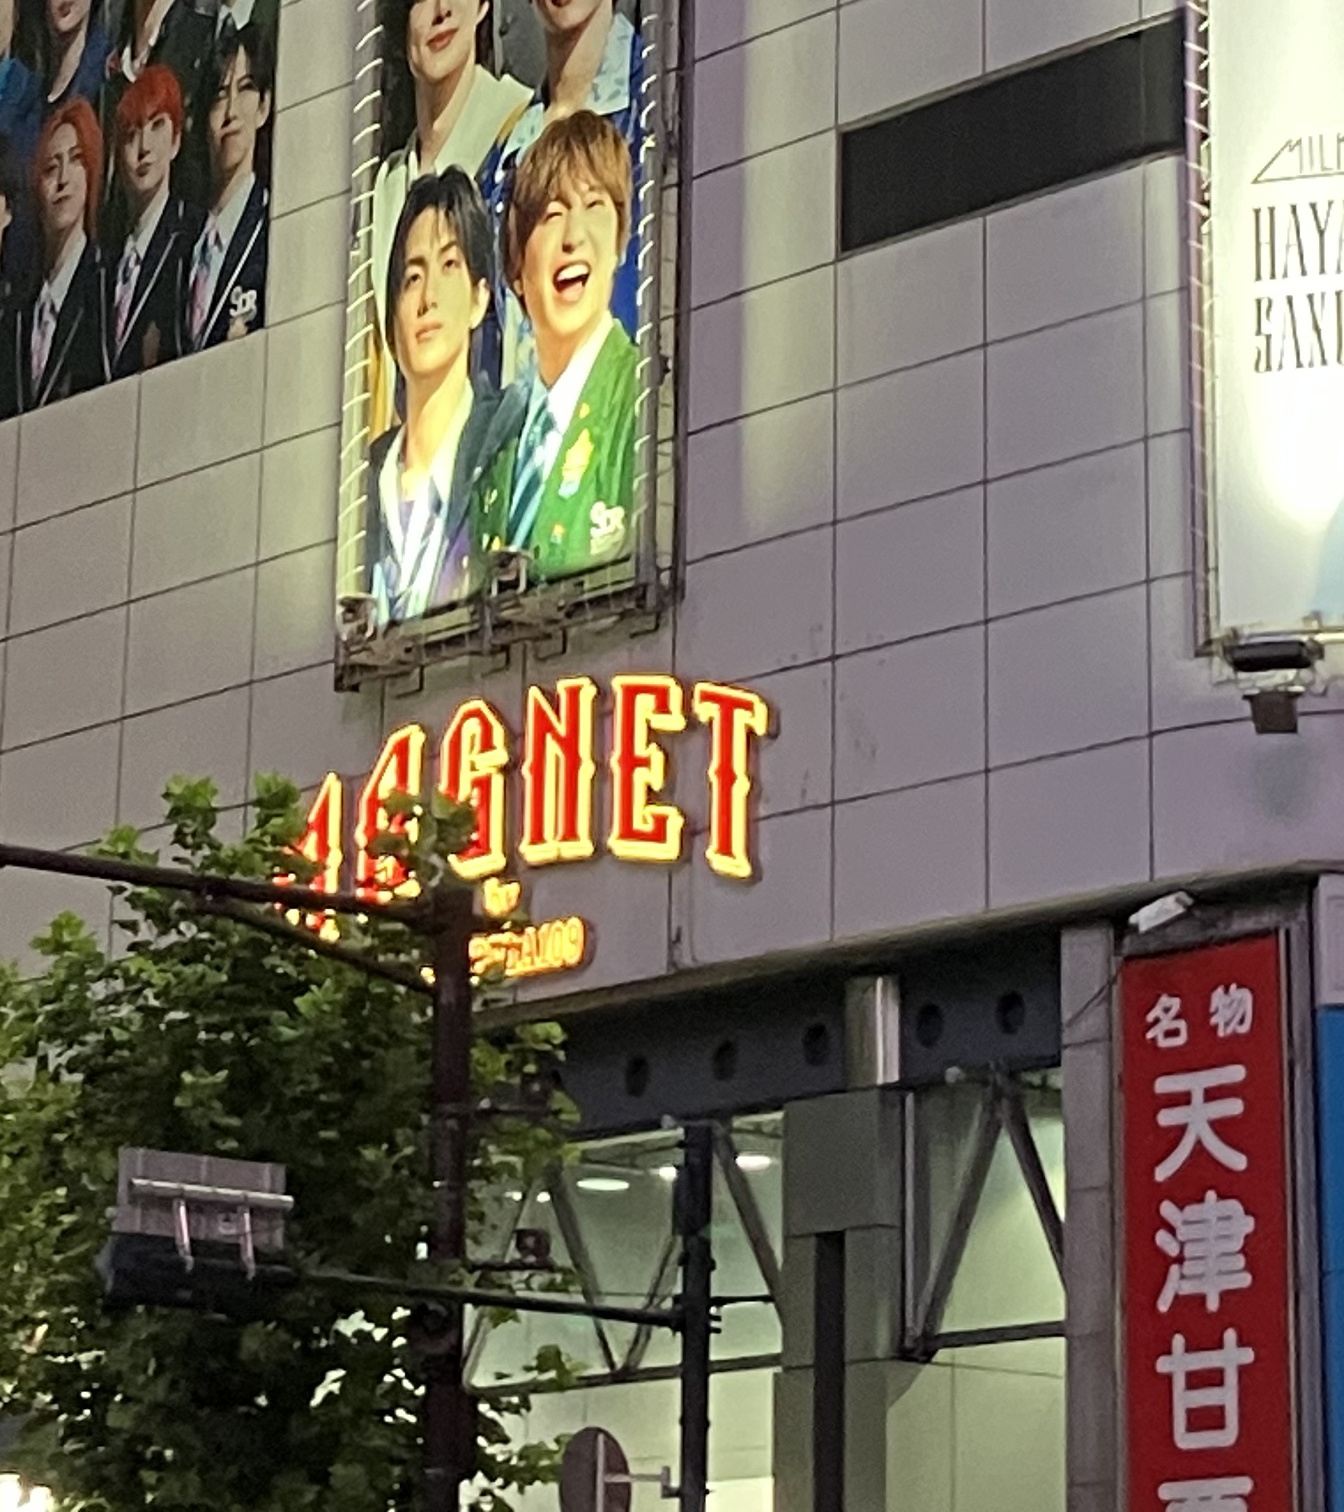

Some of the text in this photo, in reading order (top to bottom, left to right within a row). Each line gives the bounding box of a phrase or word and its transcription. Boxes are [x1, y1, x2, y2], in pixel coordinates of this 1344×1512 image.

[1145, 983, 1255, 1048] 名物
[1154, 1063, 1256, 1512] 天津甘
